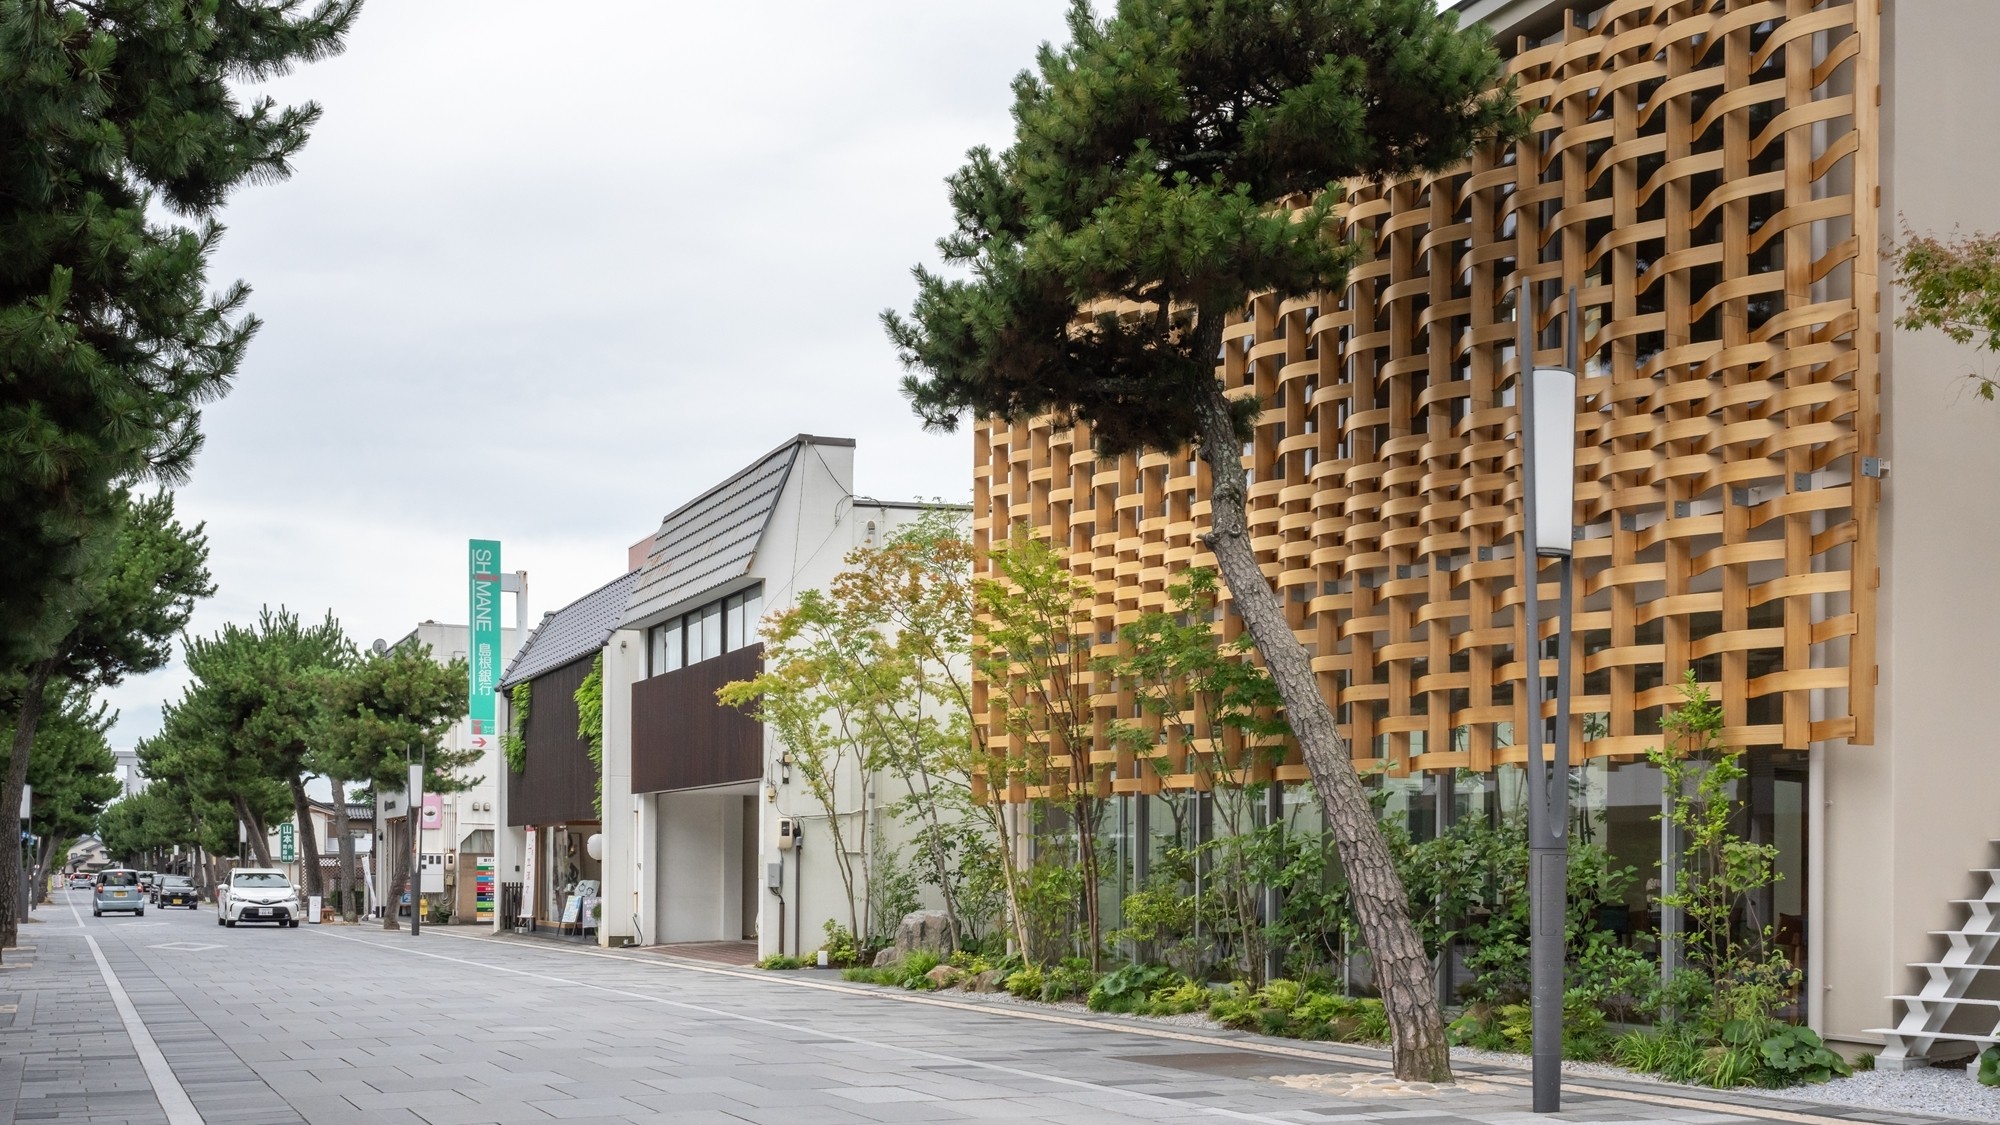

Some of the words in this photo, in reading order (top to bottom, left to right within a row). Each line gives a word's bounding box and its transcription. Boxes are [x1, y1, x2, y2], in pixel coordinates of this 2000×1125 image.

[478, 642, 493, 696] 島根銀行
[283, 825, 292, 844] 山本
